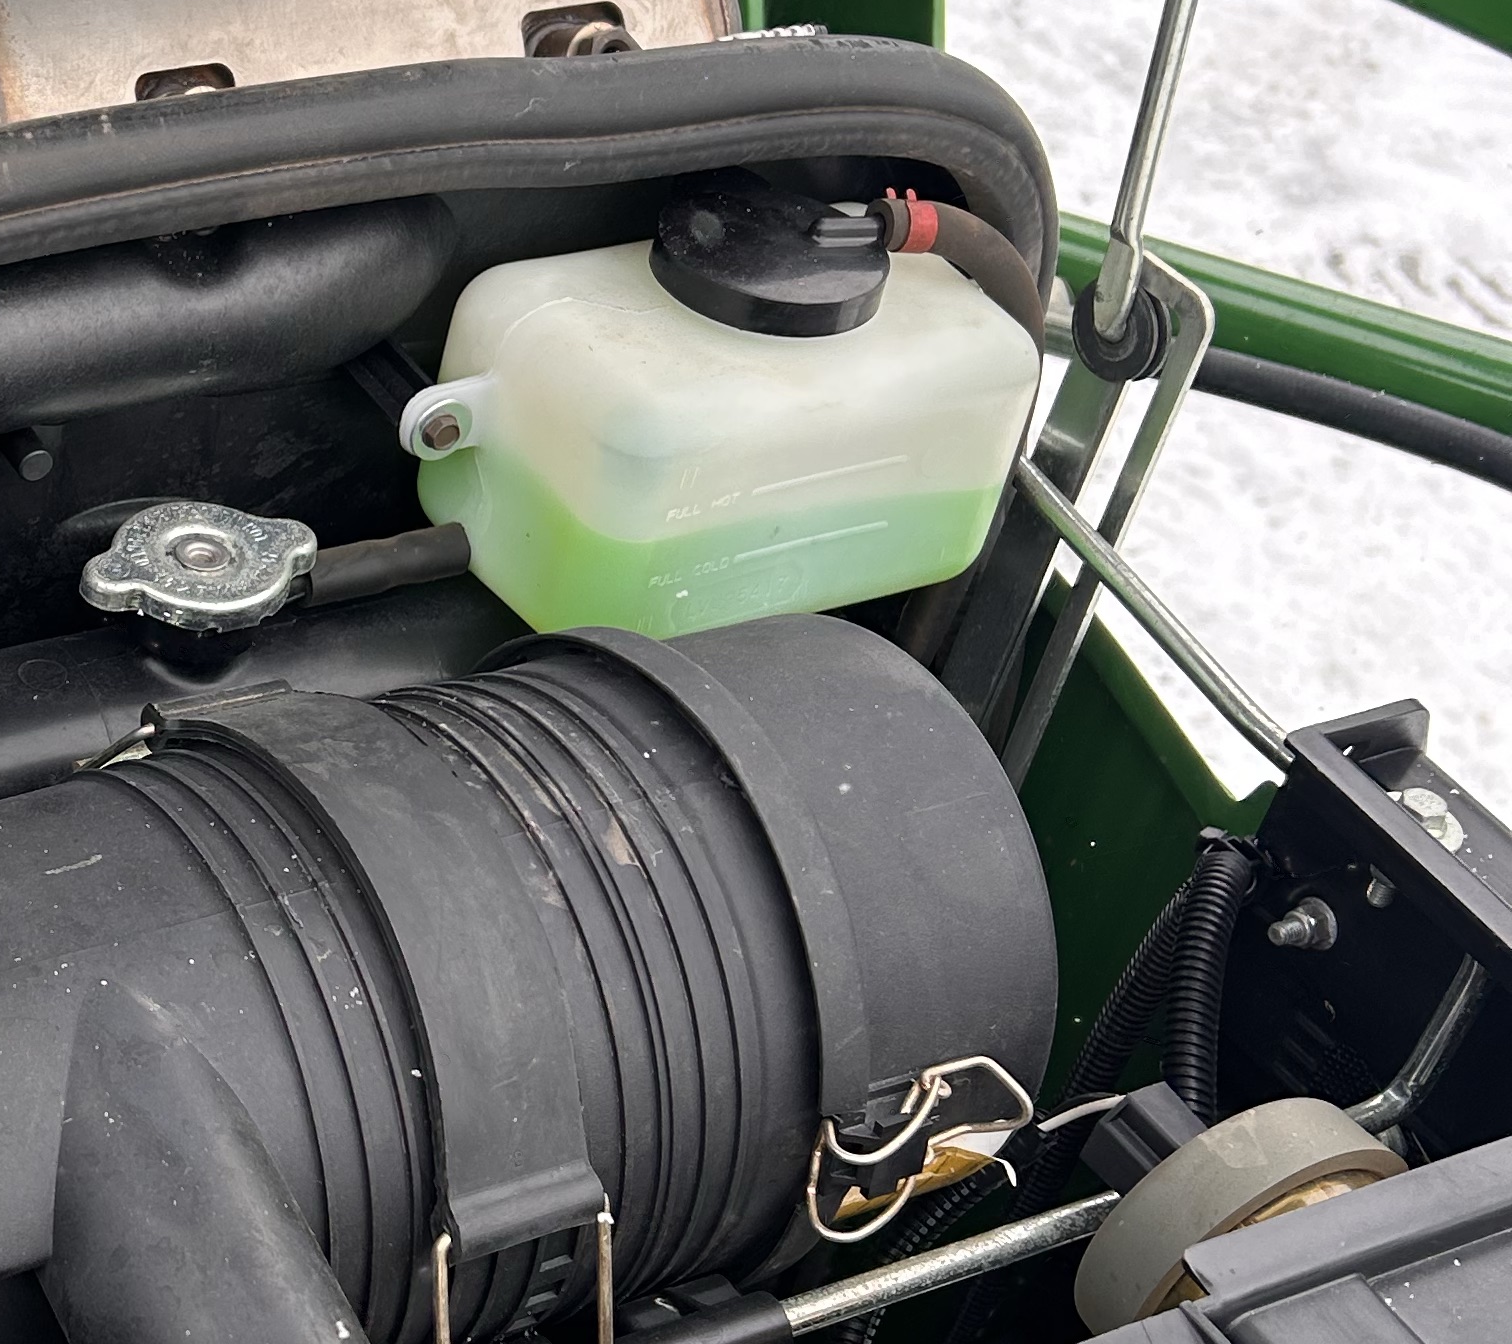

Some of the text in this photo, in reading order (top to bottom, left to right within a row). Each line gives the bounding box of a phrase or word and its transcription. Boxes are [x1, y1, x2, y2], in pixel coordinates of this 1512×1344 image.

[665, 492, 741, 522] FULL HOT
[648, 556, 730, 588] FULL COLD
